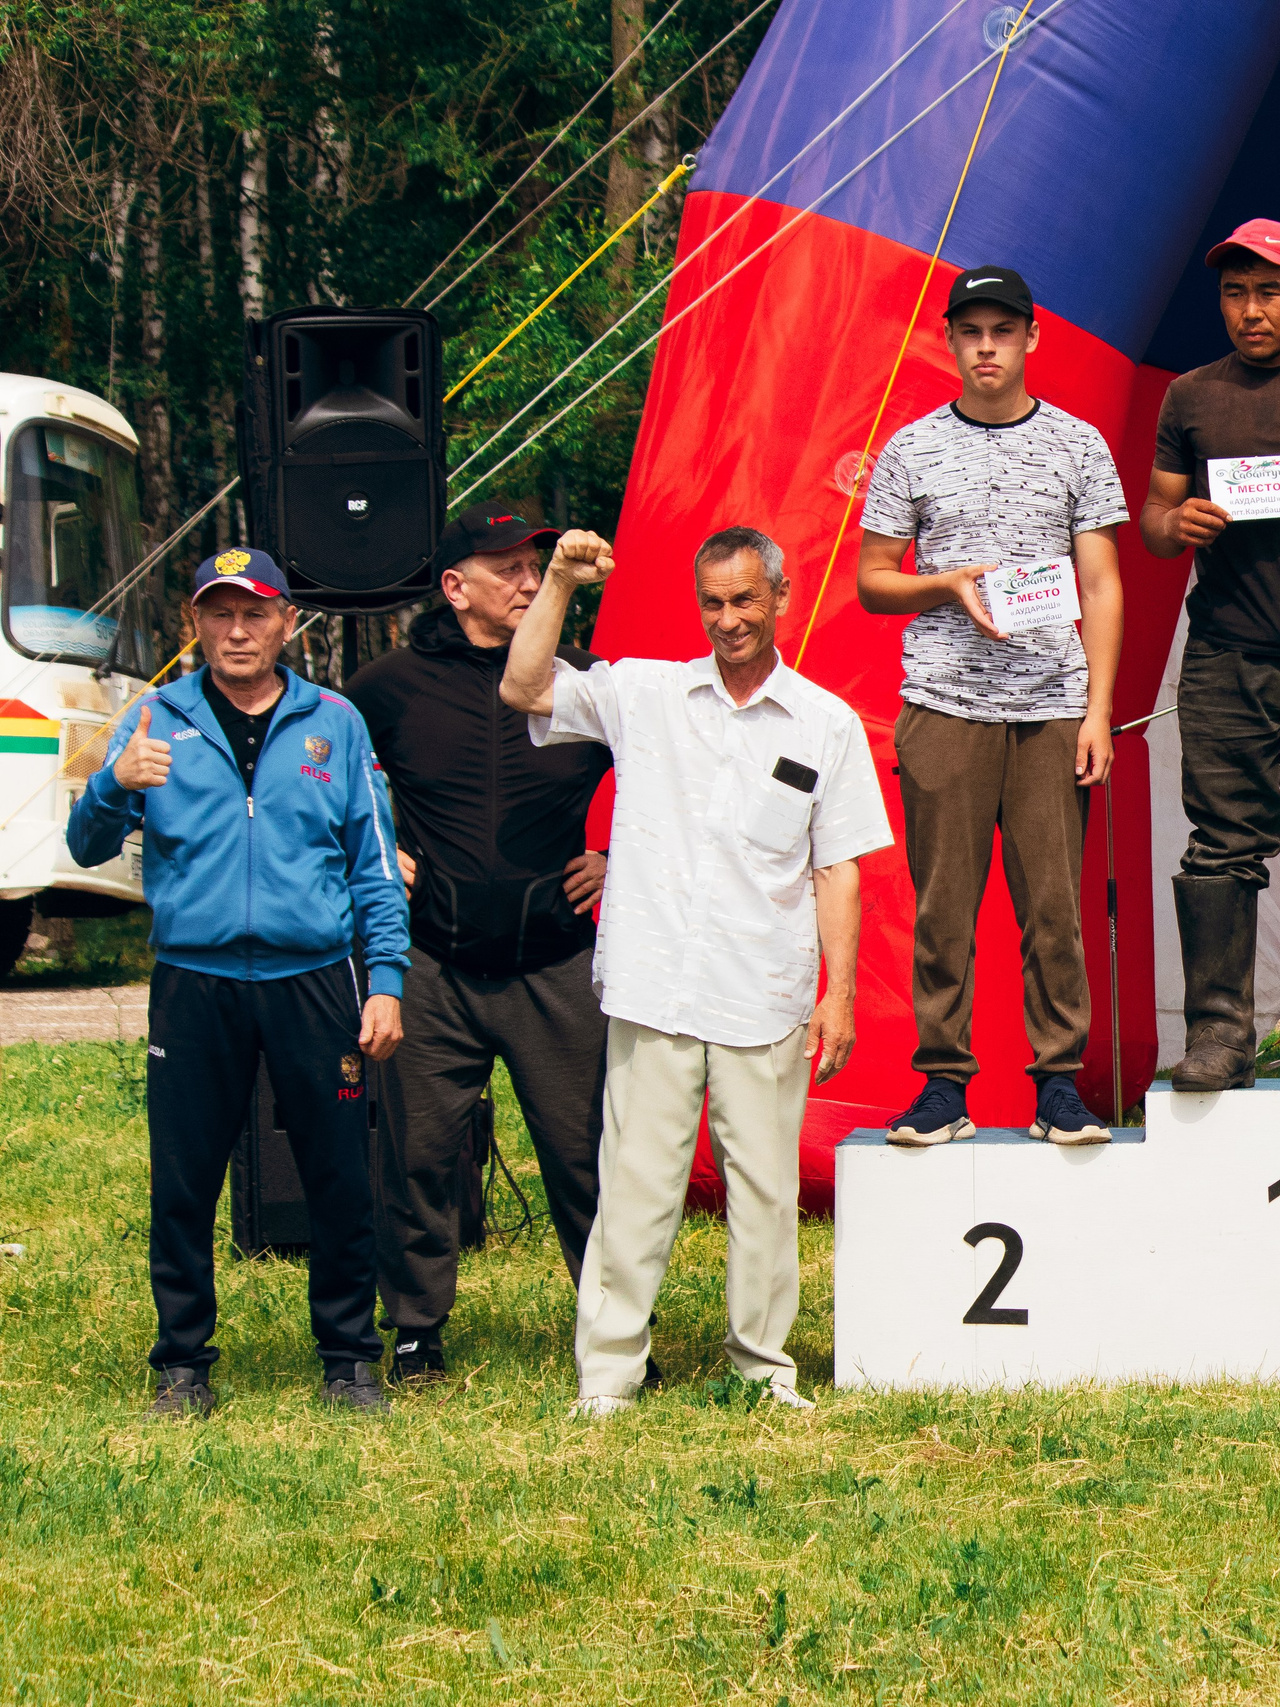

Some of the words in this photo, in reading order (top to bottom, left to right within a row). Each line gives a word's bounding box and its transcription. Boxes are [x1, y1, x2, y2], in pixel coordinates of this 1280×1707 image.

[1227, 486, 1233, 494] 1
[1238, 482, 1280, 494] МЕСТО
[347, 499, 368, 511] RCF
[1230, 496, 1280, 506] «АУДАРЫШ»
[1231, 507, 1280, 517] пгт.Карабаш
[1010, 571, 1062, 590] Сабантуй
[1006, 597, 1014, 606] 2
[1017, 587, 1061, 604] МЕСТО
[1010, 601, 1062, 617] «АУДАРЫШ»
[1013, 614, 1063, 628] пгт.Карабаш
[300, 764, 332, 783] RUS
[962, 1221, 1029, 1326] 2
